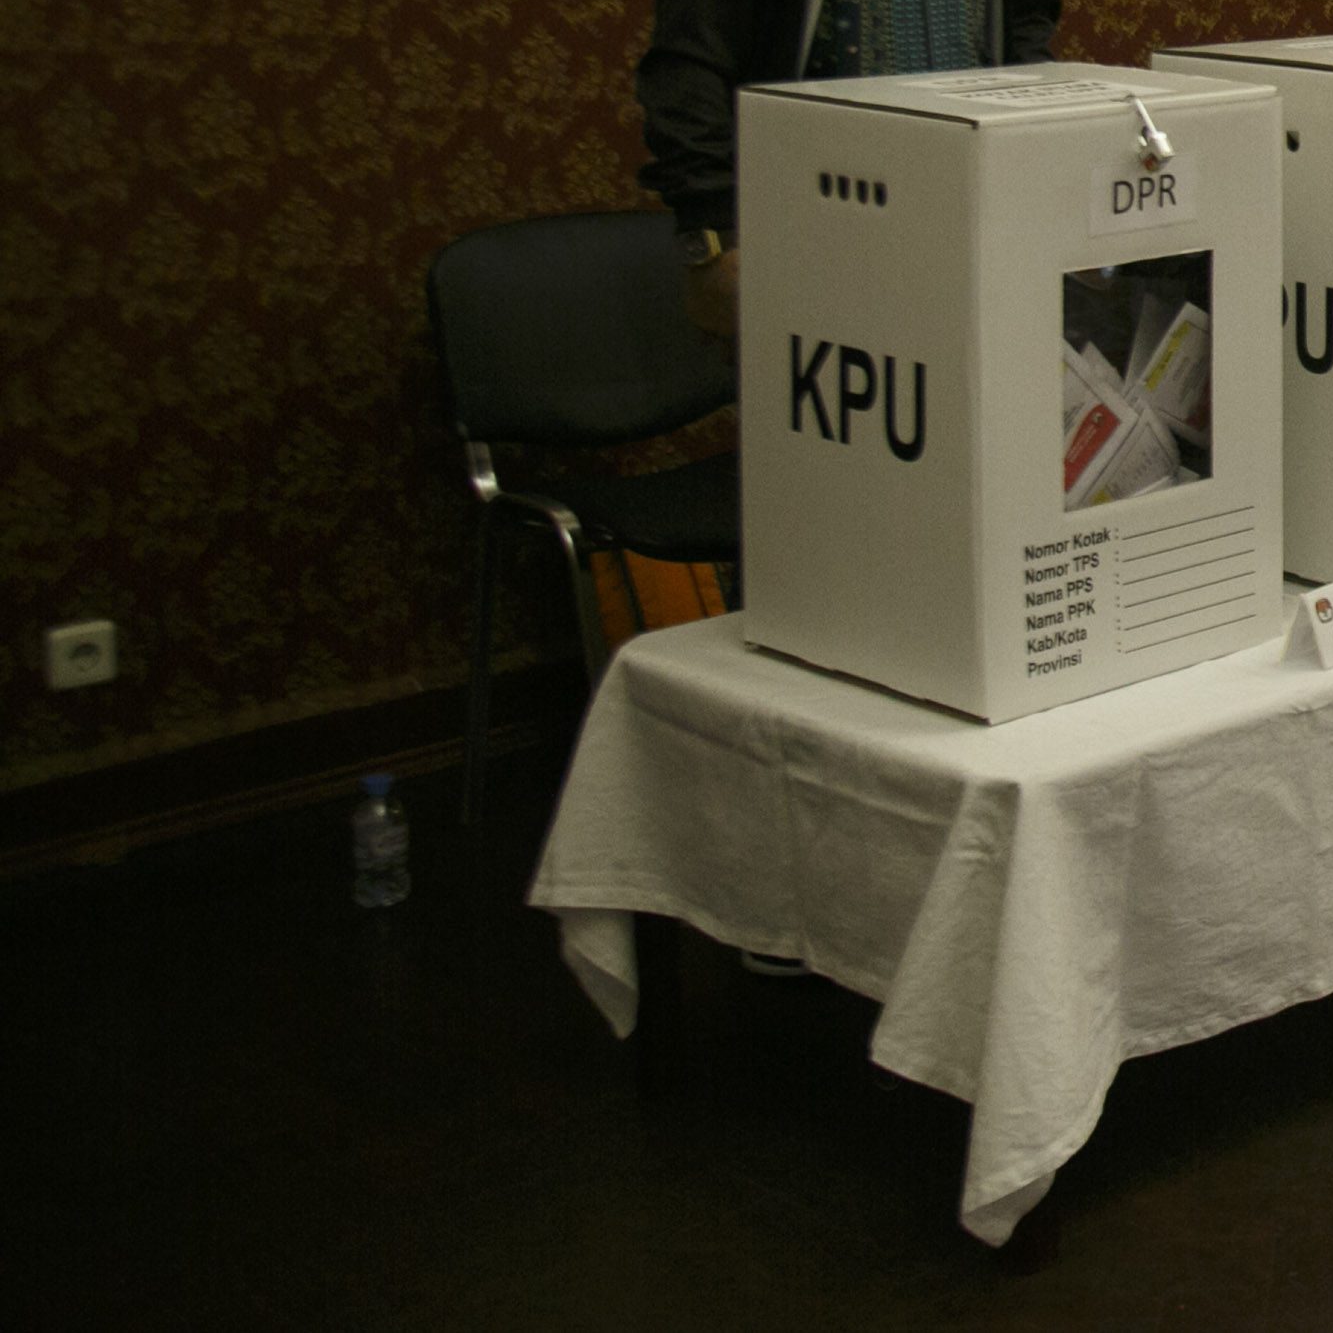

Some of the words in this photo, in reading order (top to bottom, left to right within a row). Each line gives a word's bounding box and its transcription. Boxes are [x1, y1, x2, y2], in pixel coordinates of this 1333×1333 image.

[1112, 174, 1176, 215] DPR
[790, 333, 927, 463] KPU
[1024, 540, 1069, 561] Nomor
[1073, 527, 1111, 550] Kotak
[1024, 563, 1069, 585] Nomor
[1073, 552, 1100, 572] TPS
[1025, 588, 1063, 608] Nama
[1066, 577, 1093, 597] PPS
[1026, 611, 1064, 632] Nama
[1067, 599, 1096, 621] PPK
[1027, 627, 1087, 655] Kab/Kota
[1028, 649, 1082, 678] Provinsi
